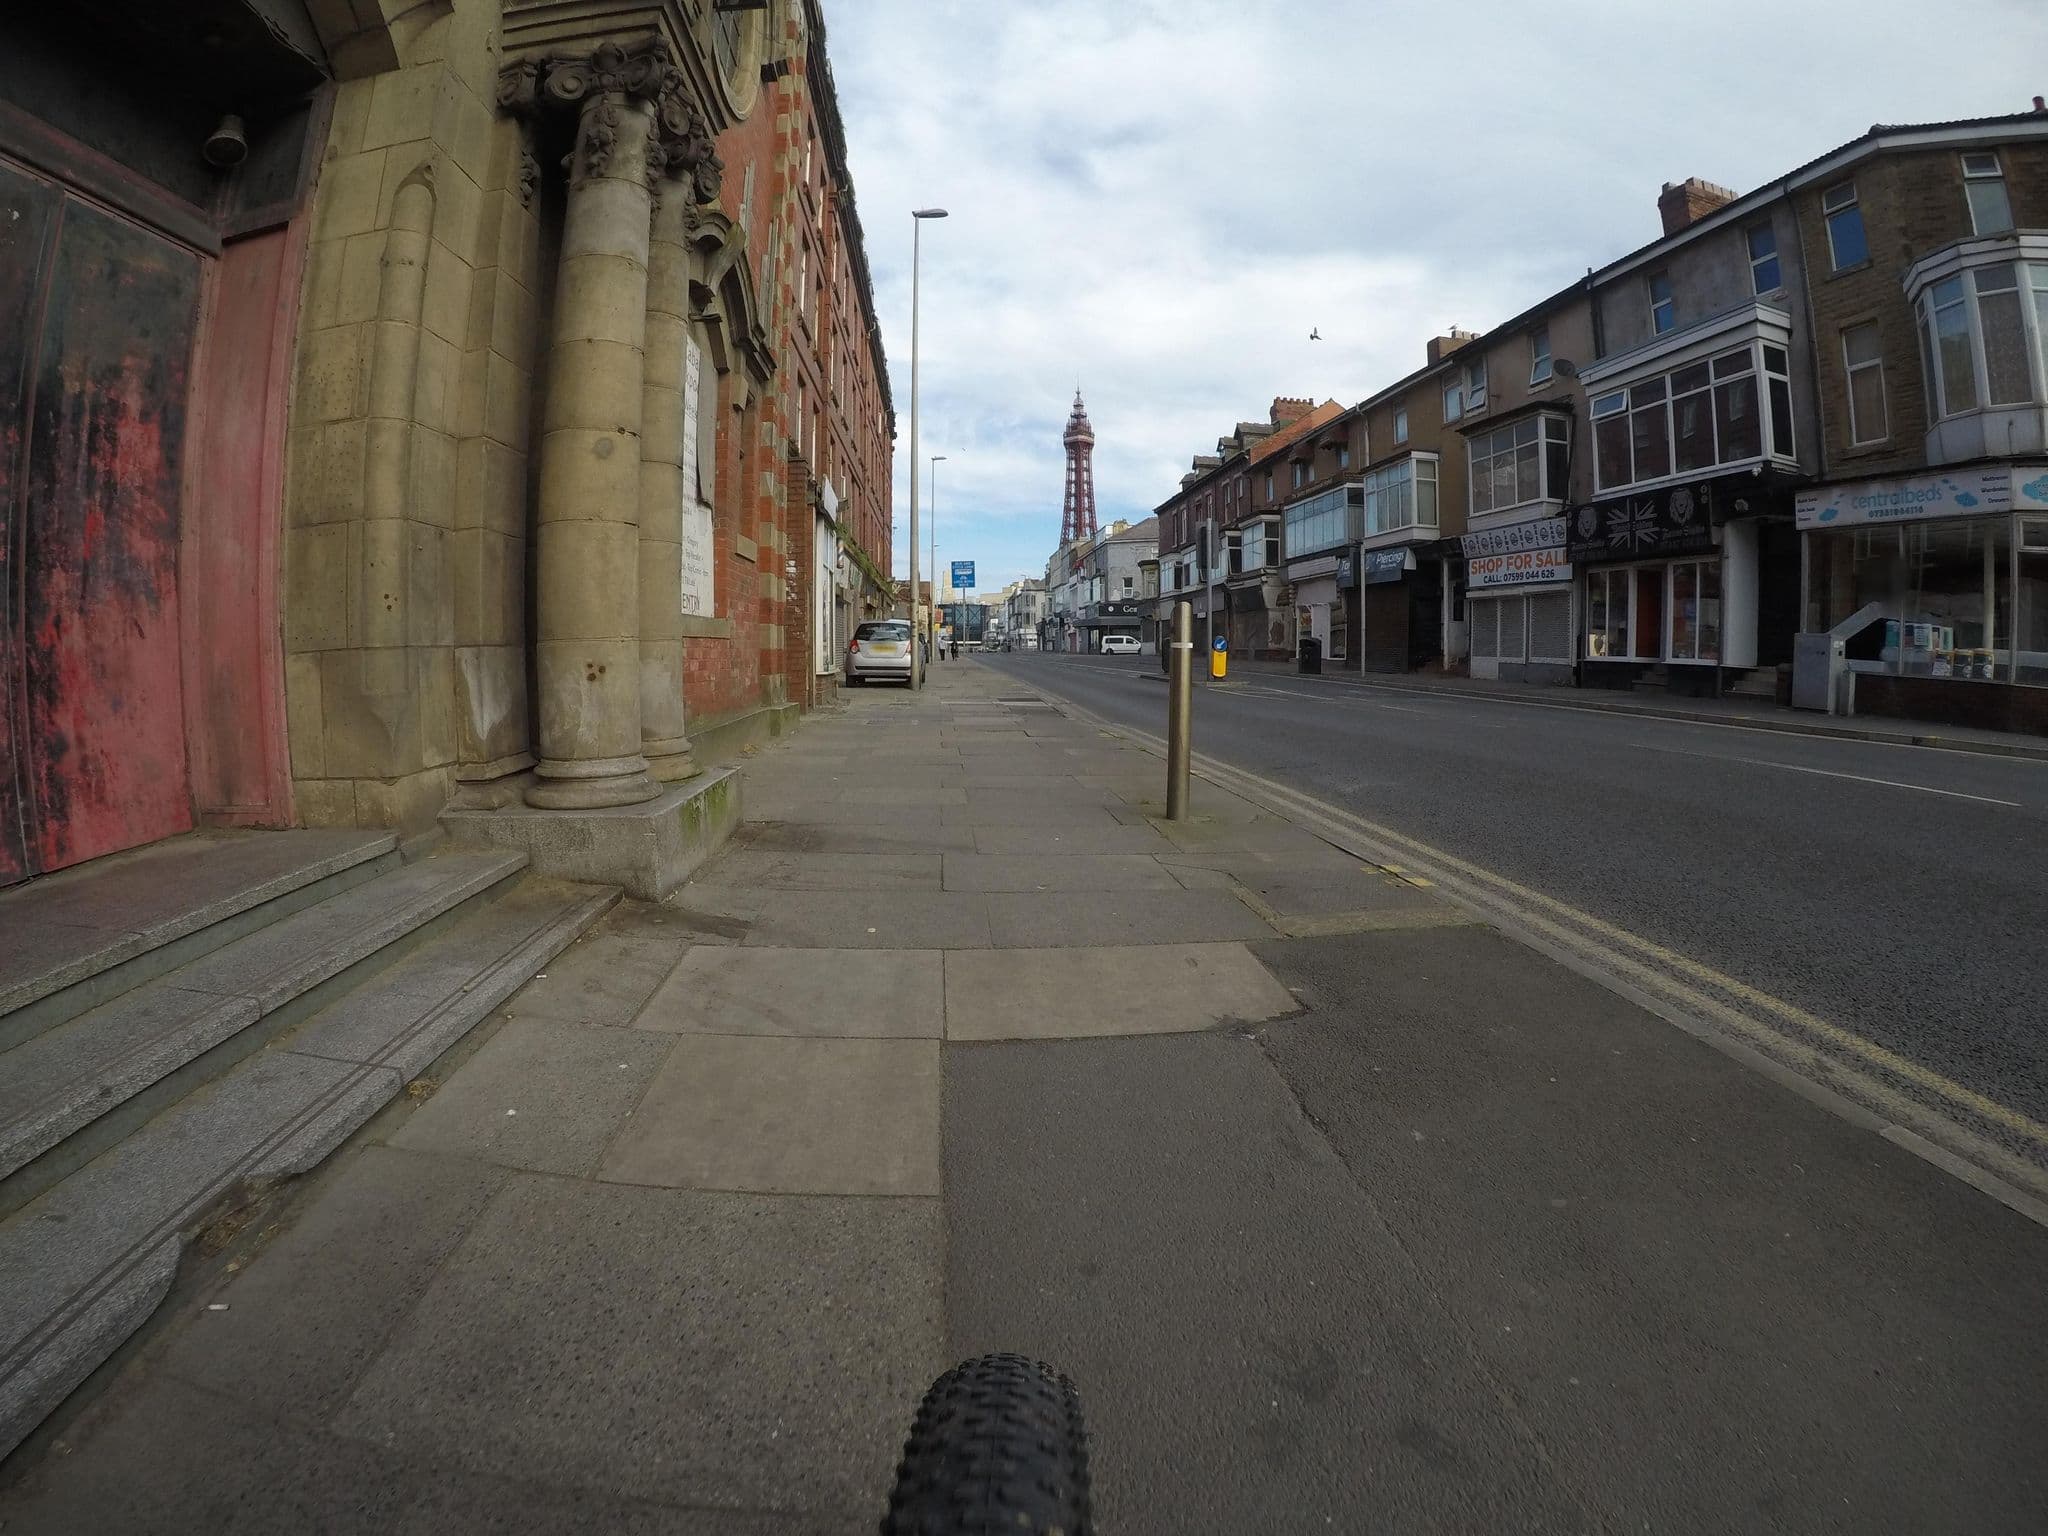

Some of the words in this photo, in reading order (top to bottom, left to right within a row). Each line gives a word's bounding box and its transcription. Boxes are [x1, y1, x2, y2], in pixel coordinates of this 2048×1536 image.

[1471, 556, 1504, 576] SHOP
[1506, 552, 1533, 571] FOR
[1483, 575, 1502, 584] CALL:
[1503, 571, 1524, 582] 07599
[1525, 570, 1540, 580] 044
[1541, 569, 1555, 579] 626
